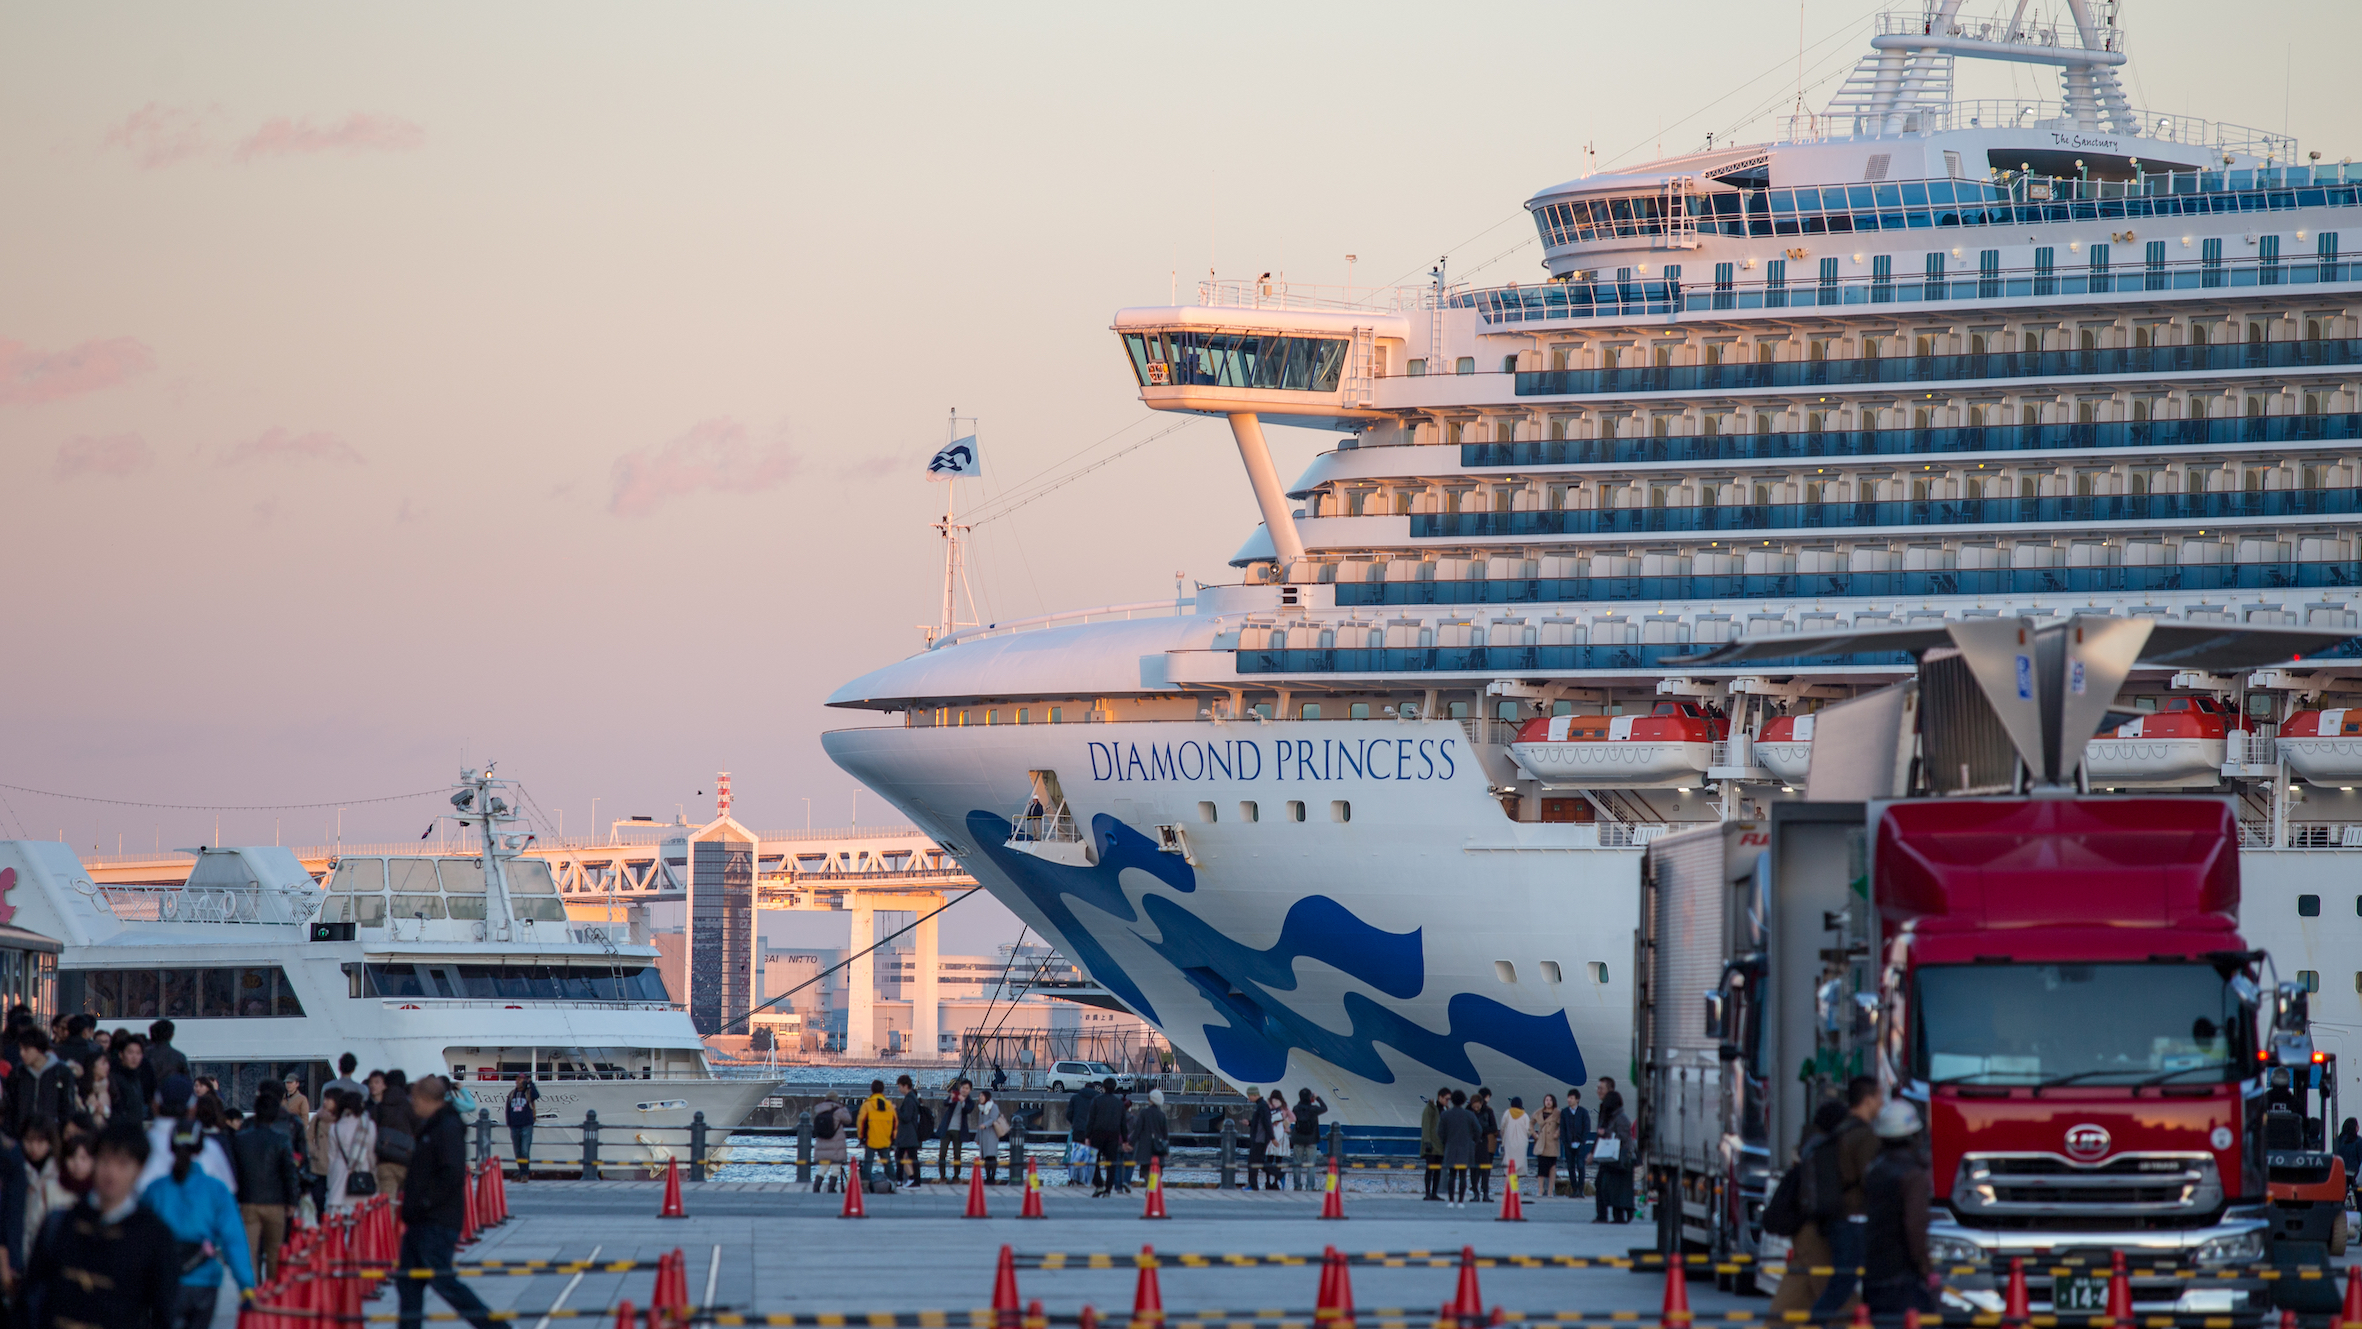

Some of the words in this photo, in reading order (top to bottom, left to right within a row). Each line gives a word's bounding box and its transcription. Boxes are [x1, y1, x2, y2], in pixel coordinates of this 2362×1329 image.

[2051, 132, 2069, 145] The
[2071, 134, 2119, 152] Sanctuary
[1087, 740, 1262, 782] DIAMOND
[1275, 738, 1456, 781] PRINCESS
[788, 955, 818, 964] NITTO
[468, 1090, 509, 1103] Mari
[537, 1092, 580, 1105] ouge
[511, 1098, 527, 1108] GAP
[2267, 1155, 2324, 1167] TOOTA
